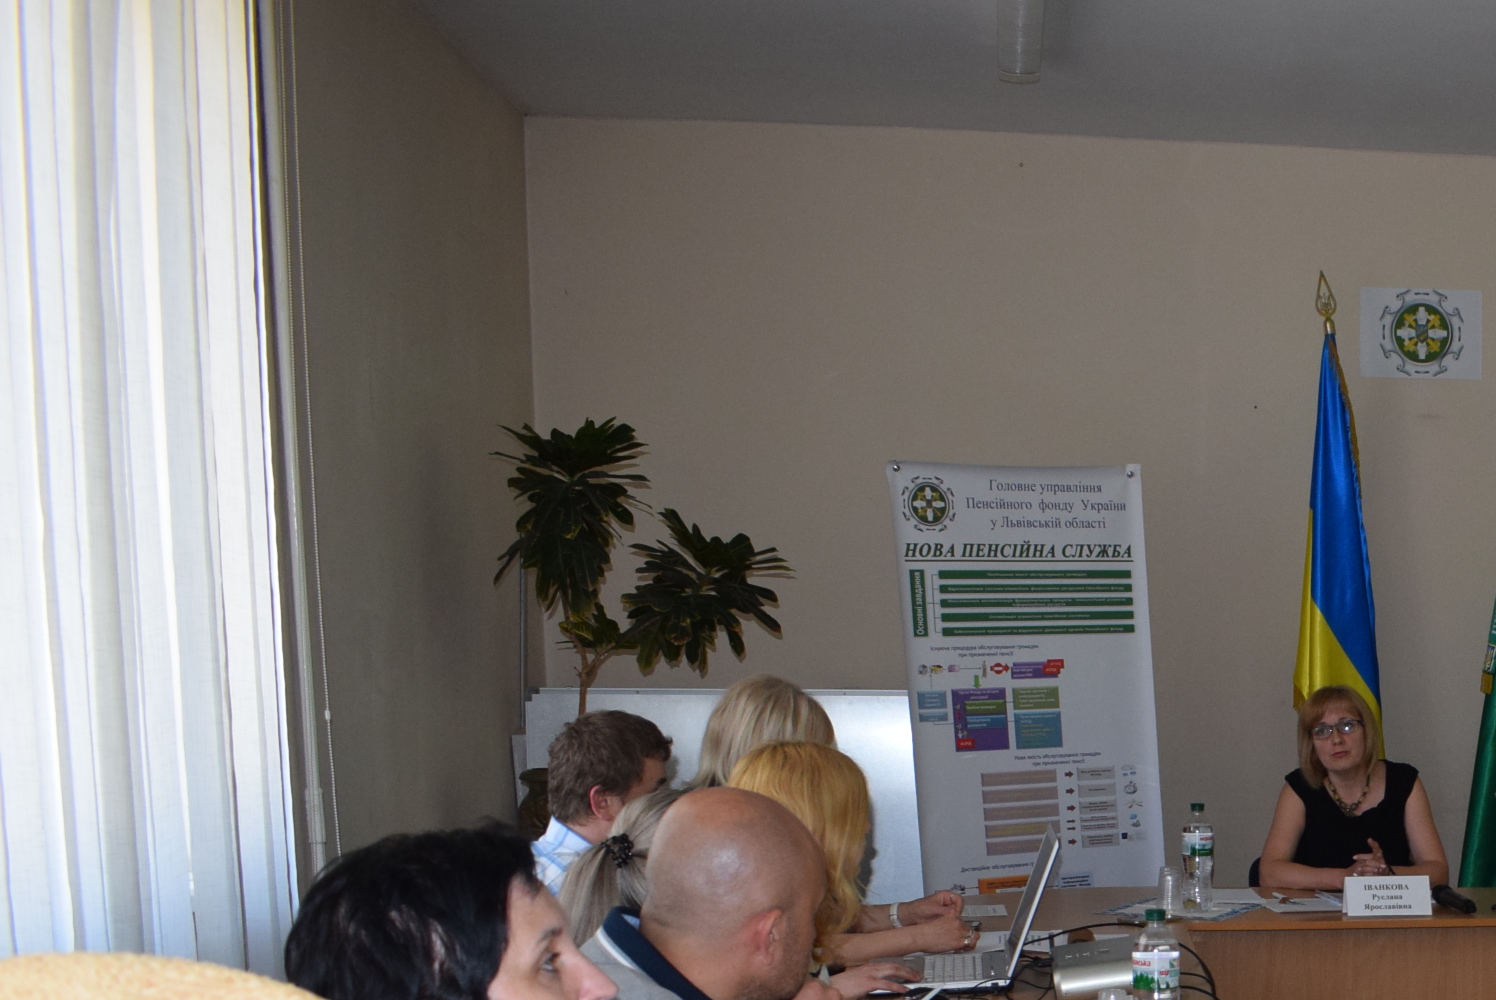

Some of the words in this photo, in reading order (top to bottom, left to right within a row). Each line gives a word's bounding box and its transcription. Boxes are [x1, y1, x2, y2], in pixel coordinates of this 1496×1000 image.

[988, 479, 1037, 493] Головне
[1039, 481, 1103, 495] управління
[965, 497, 1033, 511] Пенсійного
[1038, 499, 1075, 513] фонду
[1082, 500, 1127, 513] України
[990, 519, 998, 530] у
[1000, 516, 1062, 530] Львівській
[1064, 518, 1107, 530] області
[904, 543, 956, 558] НОВА
[960, 540, 1056, 559] ПЕНСІЙНА
[1061, 543, 1133, 559] СЛУЖБА
[913, 571, 924, 606] завдання
[914, 606, 925, 635] Основні
[1364, 903, 1412, 911] Ярославівна
